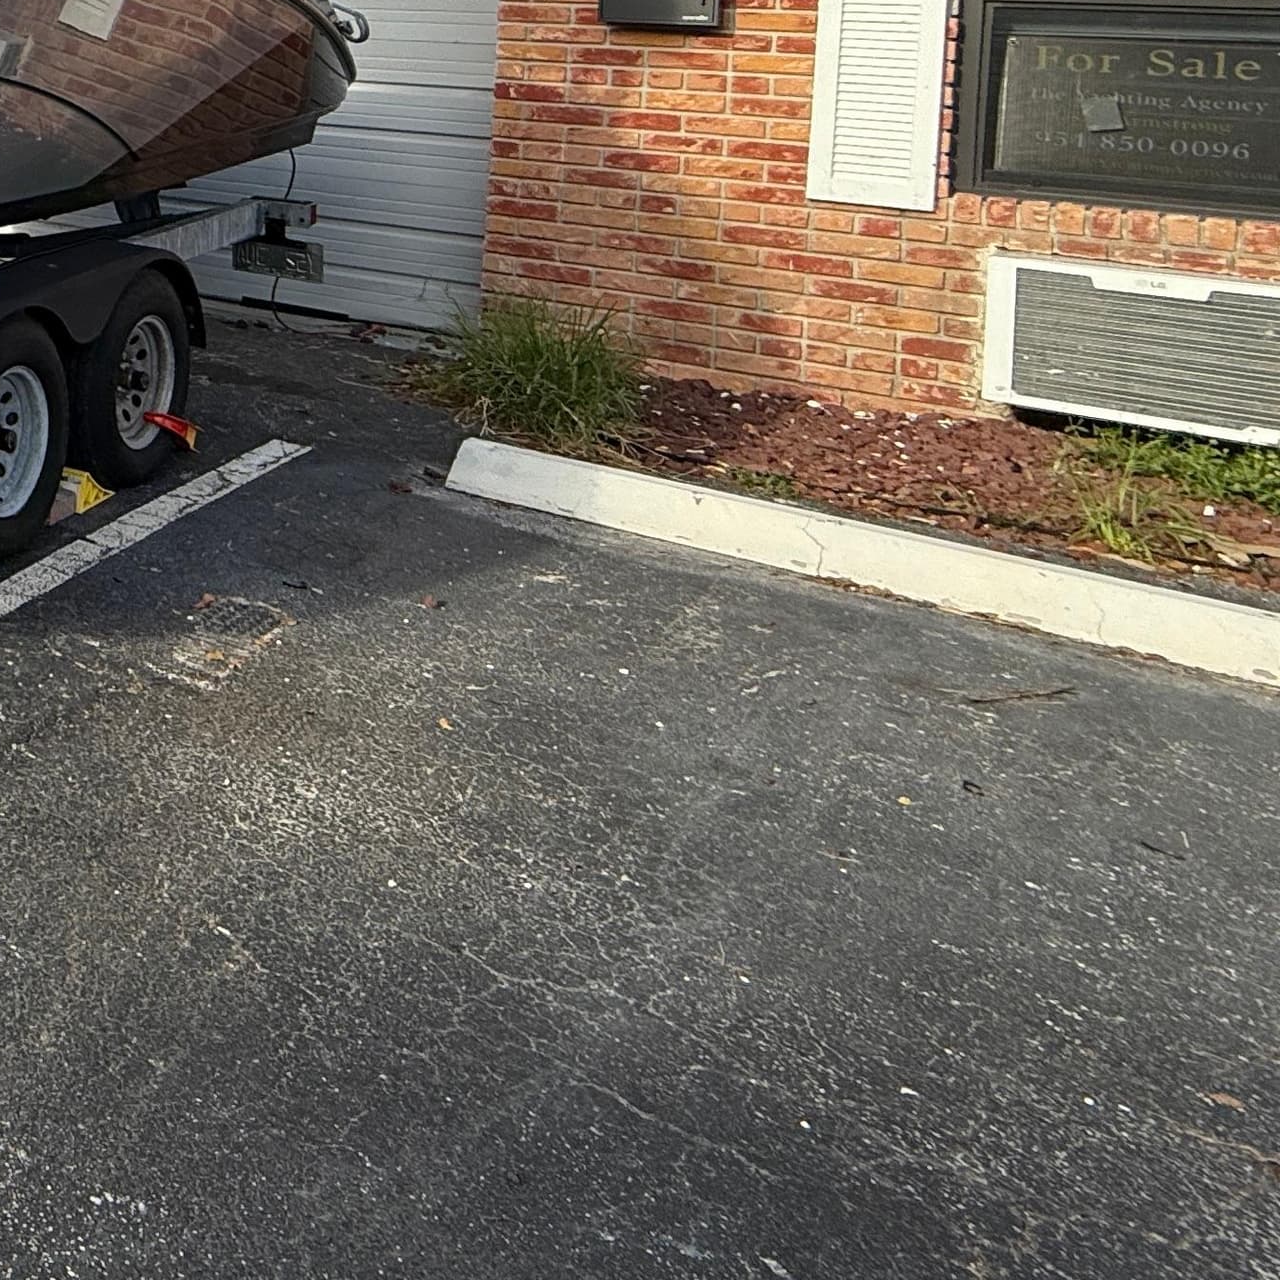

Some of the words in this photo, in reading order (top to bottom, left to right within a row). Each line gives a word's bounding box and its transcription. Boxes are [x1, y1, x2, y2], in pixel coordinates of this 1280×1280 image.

[1037, 45, 1120, 73] For
[1146, 49, 1262, 81] Sale
[1180, 95, 1269, 116] Agency
